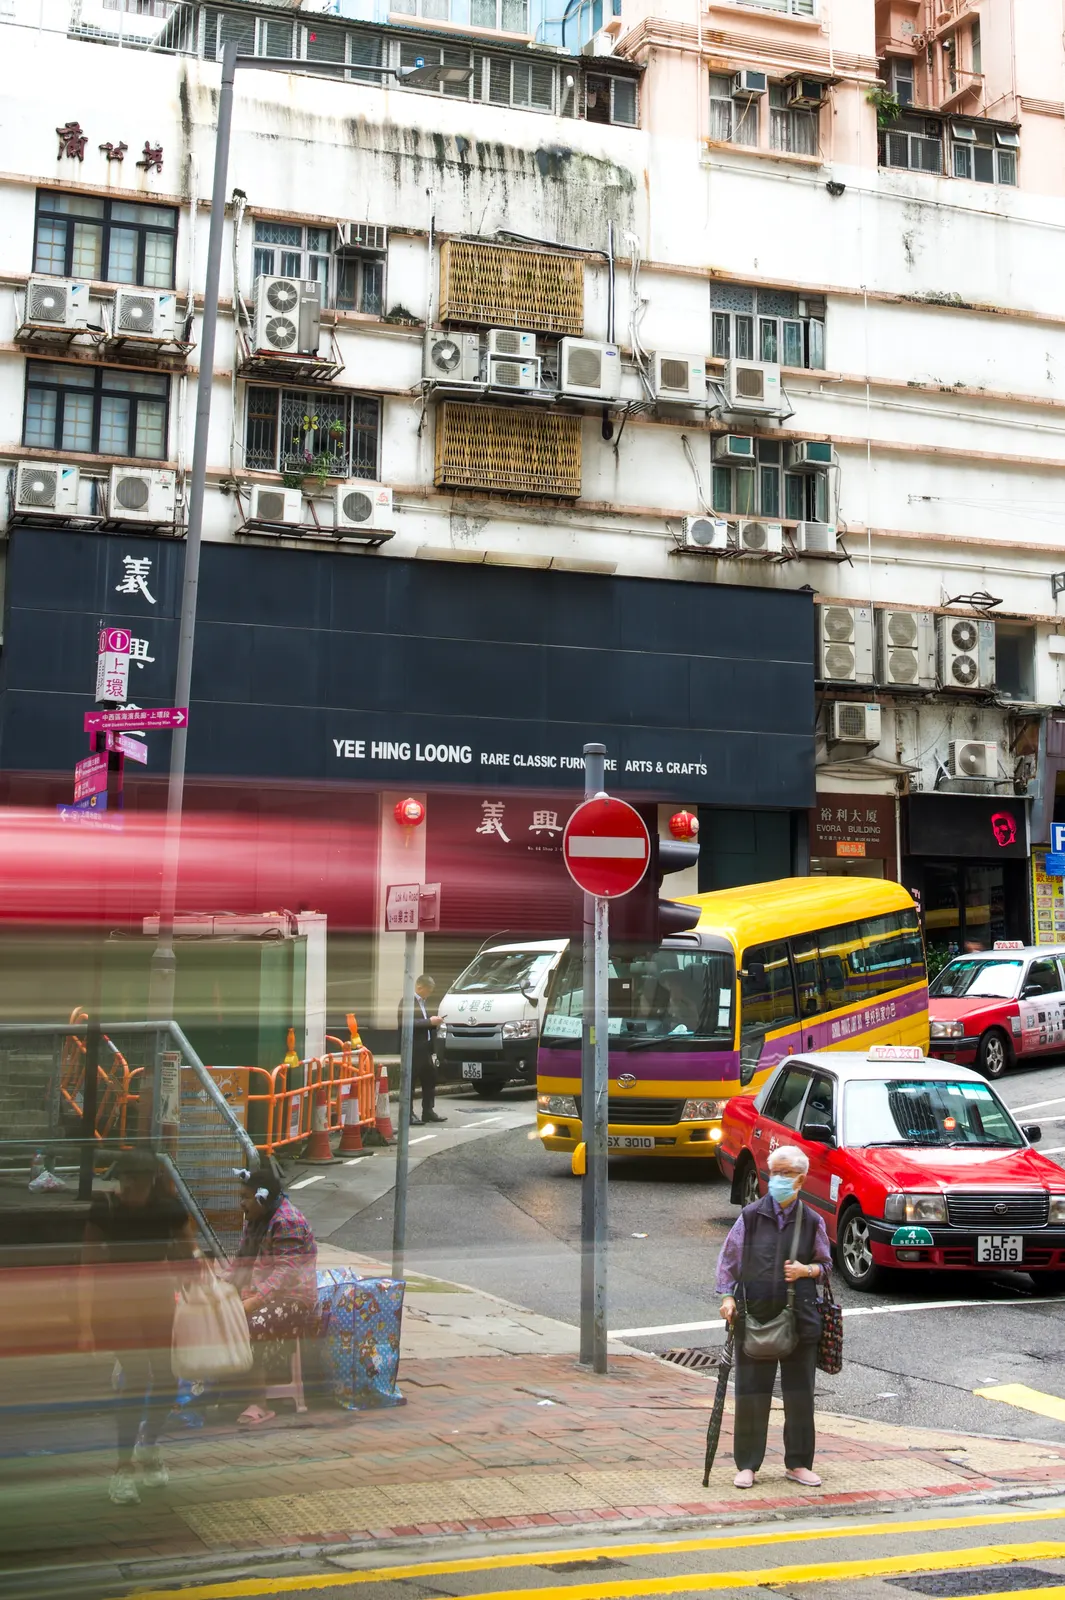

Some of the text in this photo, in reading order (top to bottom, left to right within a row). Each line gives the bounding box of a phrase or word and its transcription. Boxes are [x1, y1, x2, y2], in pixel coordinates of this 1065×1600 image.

[105, 657, 126, 697] 上環
[333, 739, 366, 758] YEE
[371, 741, 411, 761] HING
[415, 743, 472, 764] LOONG
[480, 752, 510, 765] RARE
[513, 754, 557, 768] CLASSIC
[625, 760, 653, 773] ARTS
[656, 762, 664, 773] &
[666, 762, 708, 775] CRAFTS
[816, 825, 881, 834] EVORA BUILDING
[995, 941, 1019, 949] TAXI
[875, 1047, 919, 1059] TAXI
[464, 1070, 480, 1078] 9505
[625, 1137, 651, 1148] 3010
[908, 1231, 916, 1239] 4
[990, 1236, 1010, 1248] LF
[982, 1248, 1018, 1261] 3819
